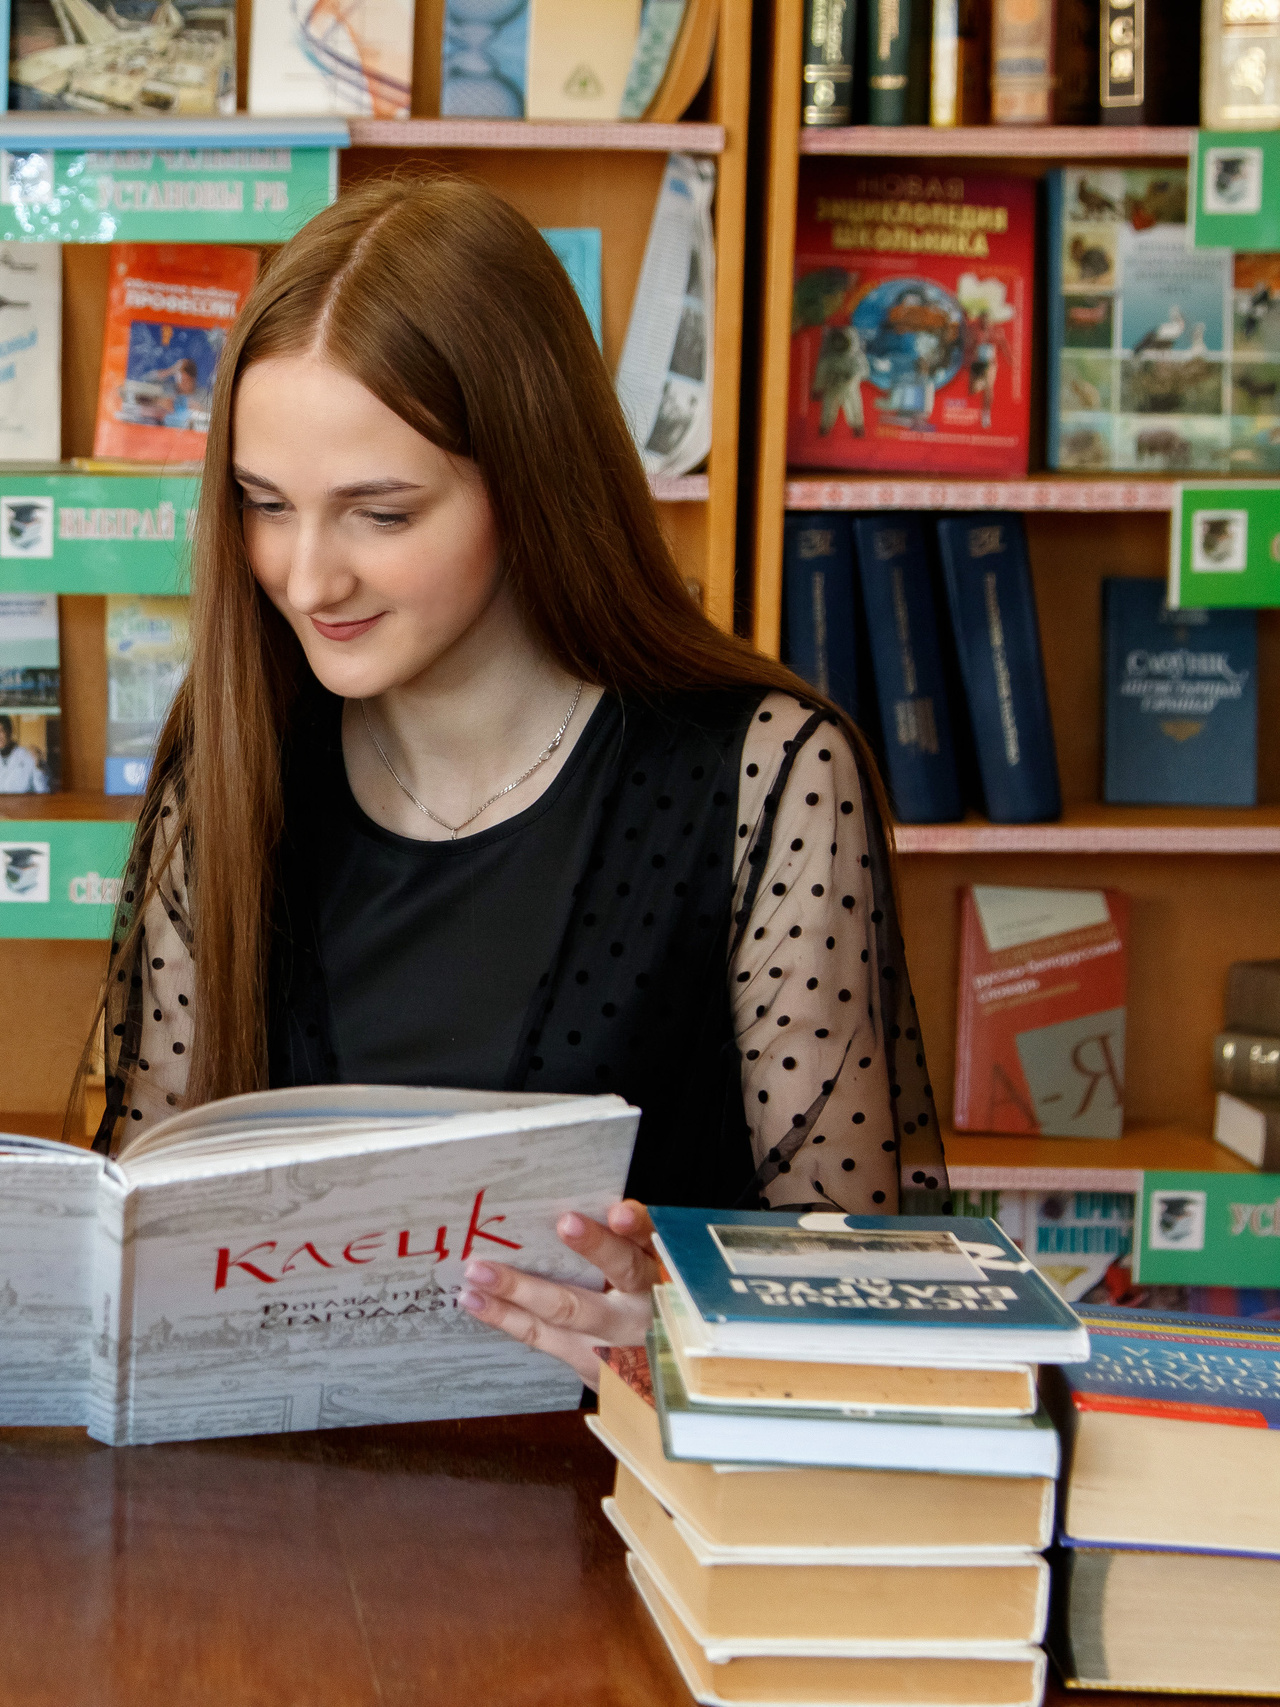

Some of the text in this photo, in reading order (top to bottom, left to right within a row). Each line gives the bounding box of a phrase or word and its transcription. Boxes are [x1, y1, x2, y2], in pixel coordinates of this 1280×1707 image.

[253, 177, 290, 213] РБ
[816, 197, 1009, 234] ЭНЦИКЛОПЕДИЯ
[830, 224, 990, 259] ШКОЛЬНИКА
